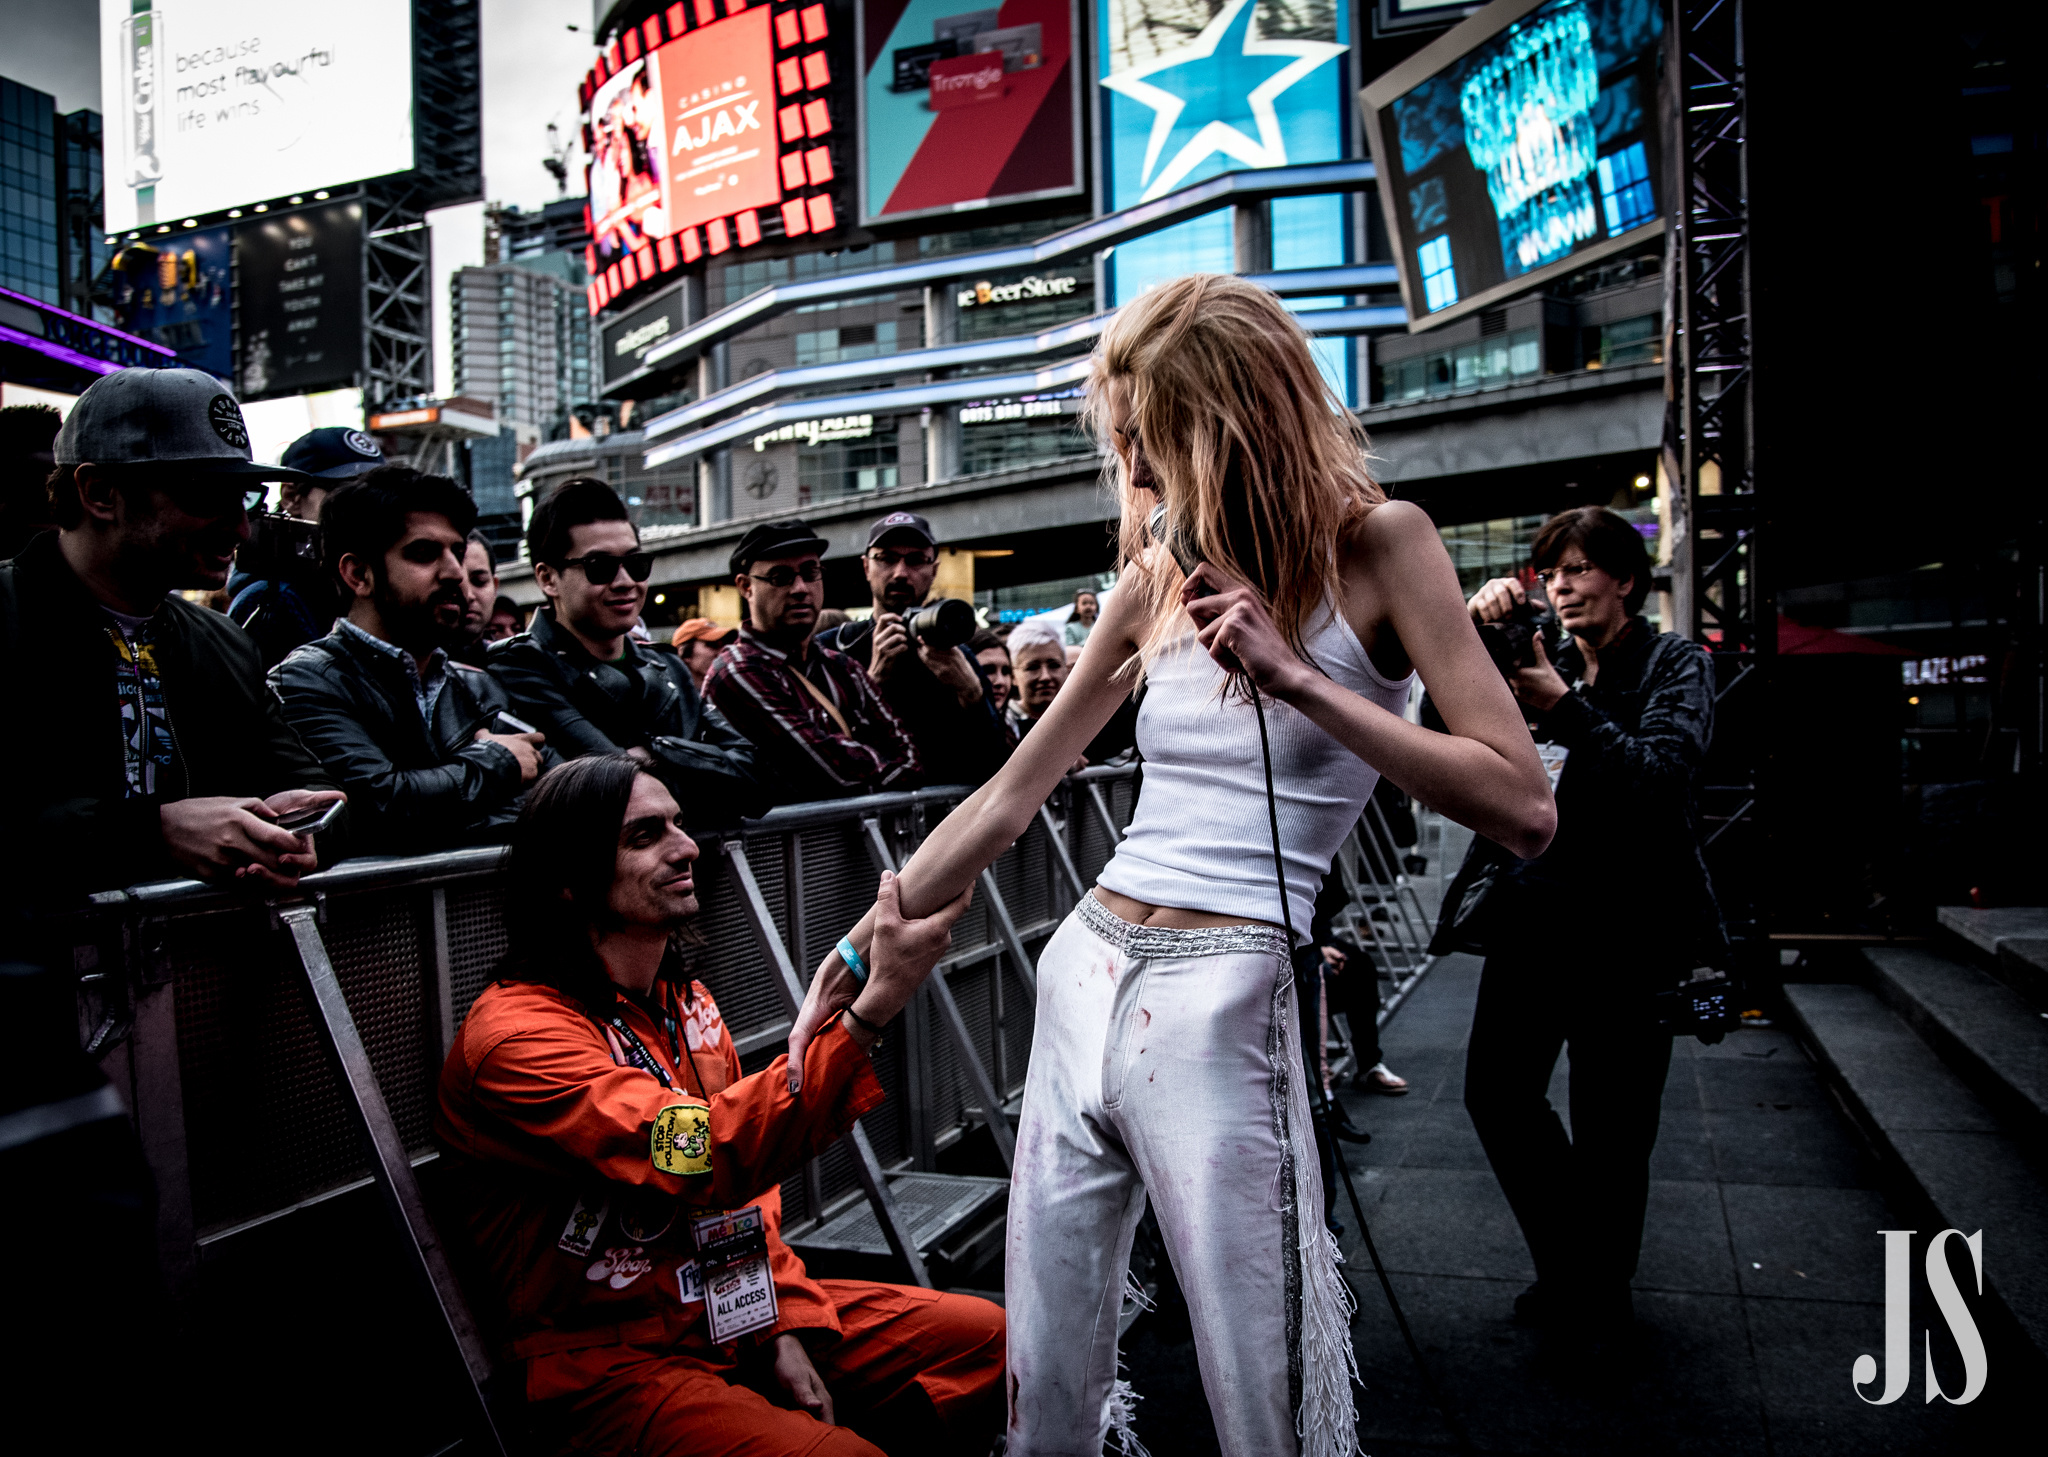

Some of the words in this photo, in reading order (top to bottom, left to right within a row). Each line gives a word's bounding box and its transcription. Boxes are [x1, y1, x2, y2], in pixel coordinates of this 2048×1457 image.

[176, 37, 261, 73] because
[177, 74, 226, 102] most
[678, 75, 748, 109] CASINO
[178, 109, 206, 133] life
[671, 99, 761, 157] AJAX
[620, 1023, 639, 1044] CBC
[638, 1044, 661, 1076] MUSIC
[655, 1125, 666, 1152] STOP
[586, 1246, 652, 1290] Sloan
[717, 1301, 733, 1316] ALL
[735, 1288, 767, 1311] ACCESS
